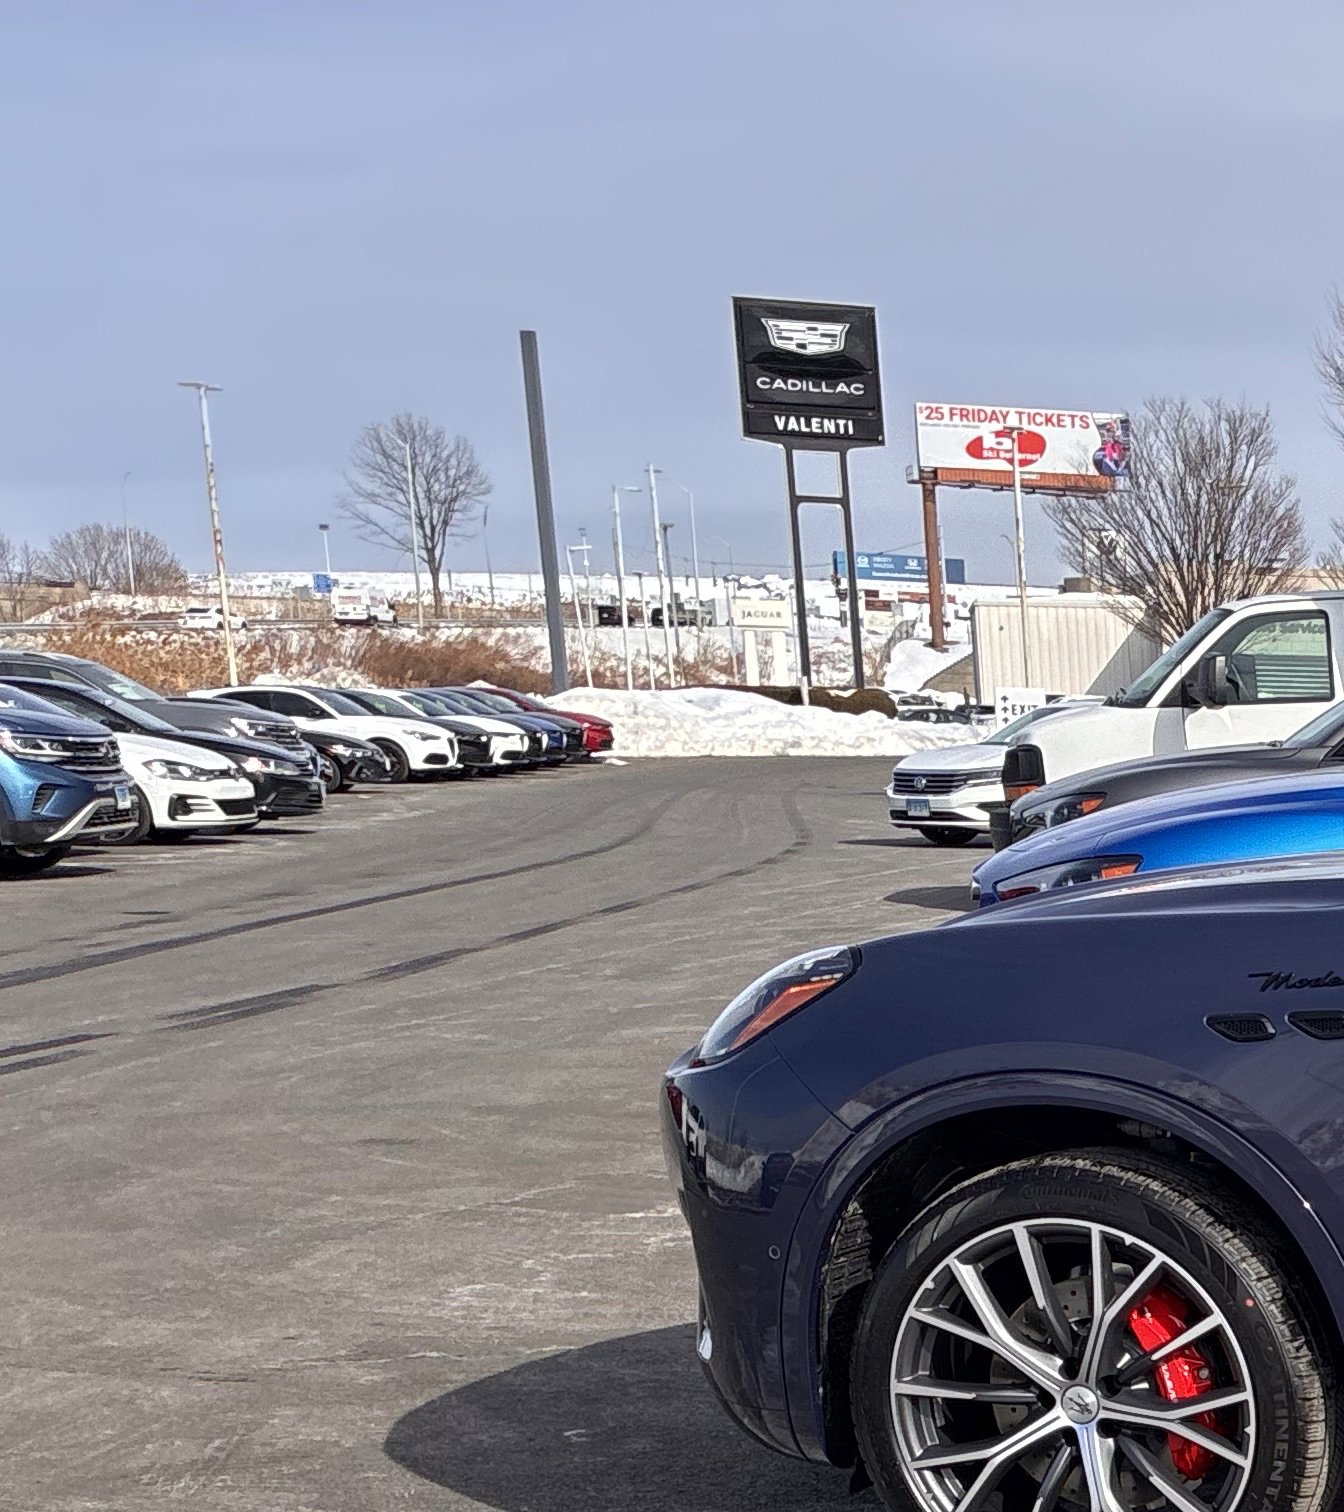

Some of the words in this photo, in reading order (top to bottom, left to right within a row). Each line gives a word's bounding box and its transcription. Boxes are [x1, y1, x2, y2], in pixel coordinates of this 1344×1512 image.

[756, 376, 865, 396] CADILLAC
[773, 415, 854, 435] VALENTI
[918, 405, 945, 421] $25
[949, 407, 1010, 425] FRIDAY
[1015, 410, 1091, 430] TICKETS
[741, 610, 782, 620] JAGUAR
